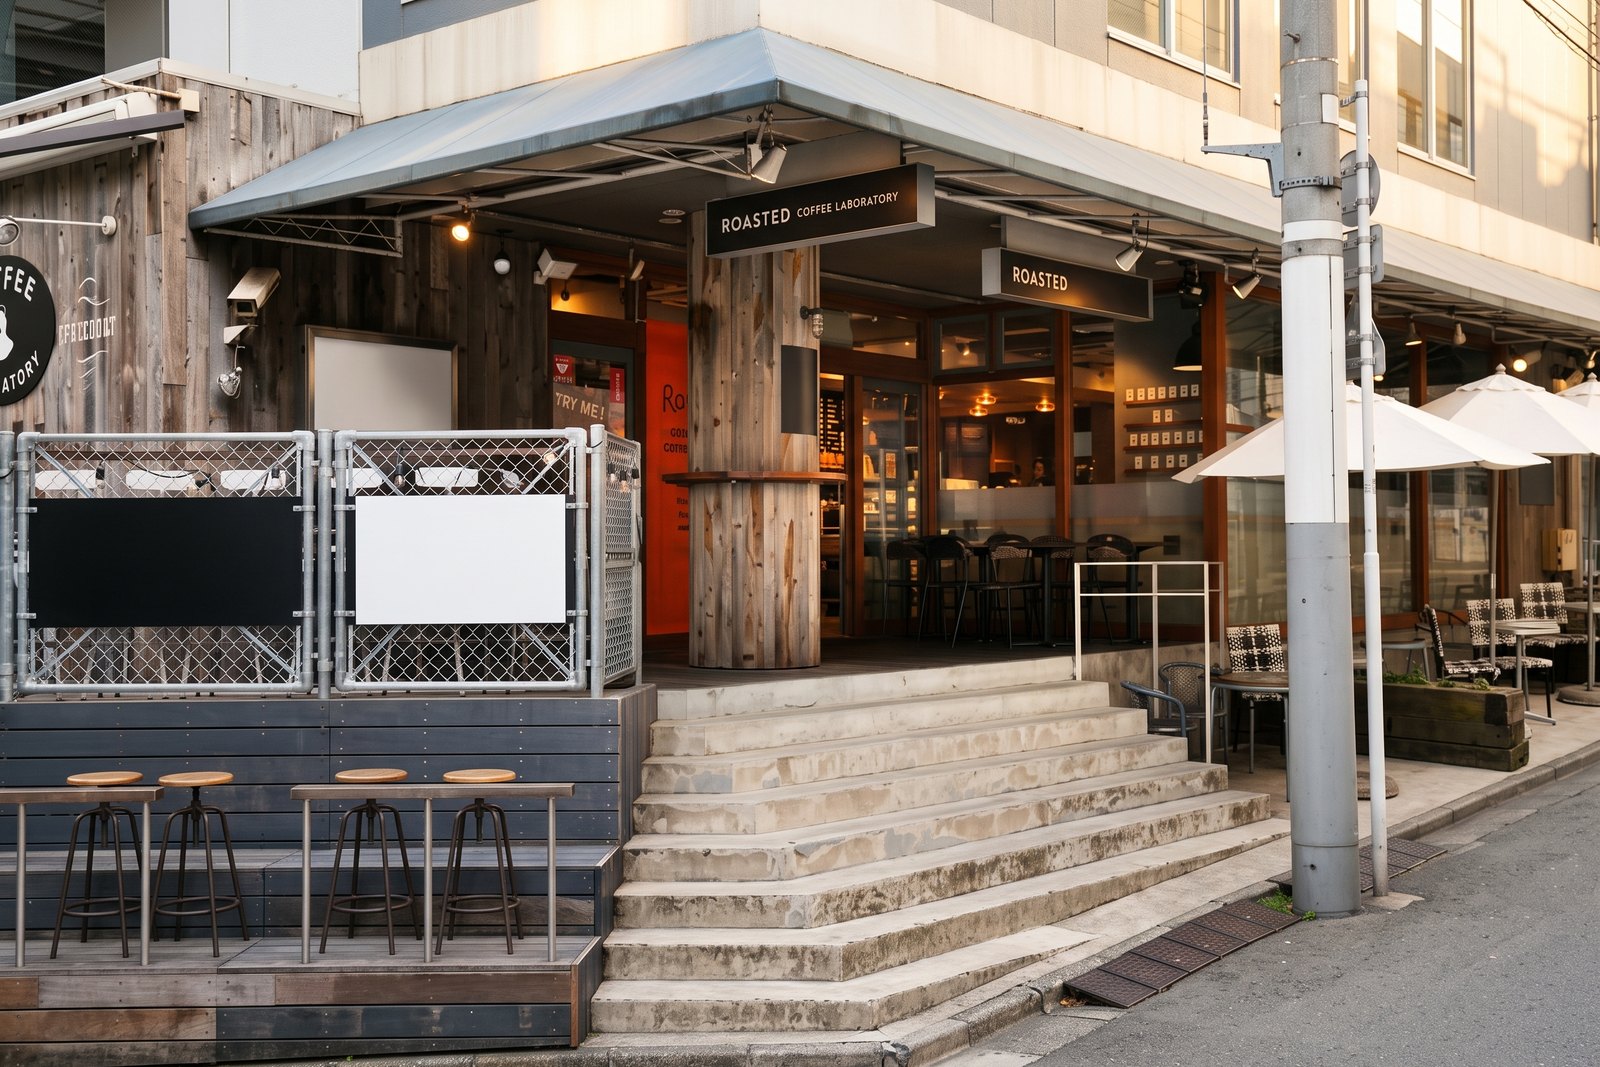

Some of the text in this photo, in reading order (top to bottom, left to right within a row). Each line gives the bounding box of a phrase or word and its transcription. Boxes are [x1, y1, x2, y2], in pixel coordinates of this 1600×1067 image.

[721, 191, 899, 234] ROASTED COFFEE LABORATORY
[0, 266, 36, 302] FEE
[1012, 266, 1068, 291] ROASTED
[2, 350, 39, 393] ATORY
[555, 392, 578, 411] TRY
